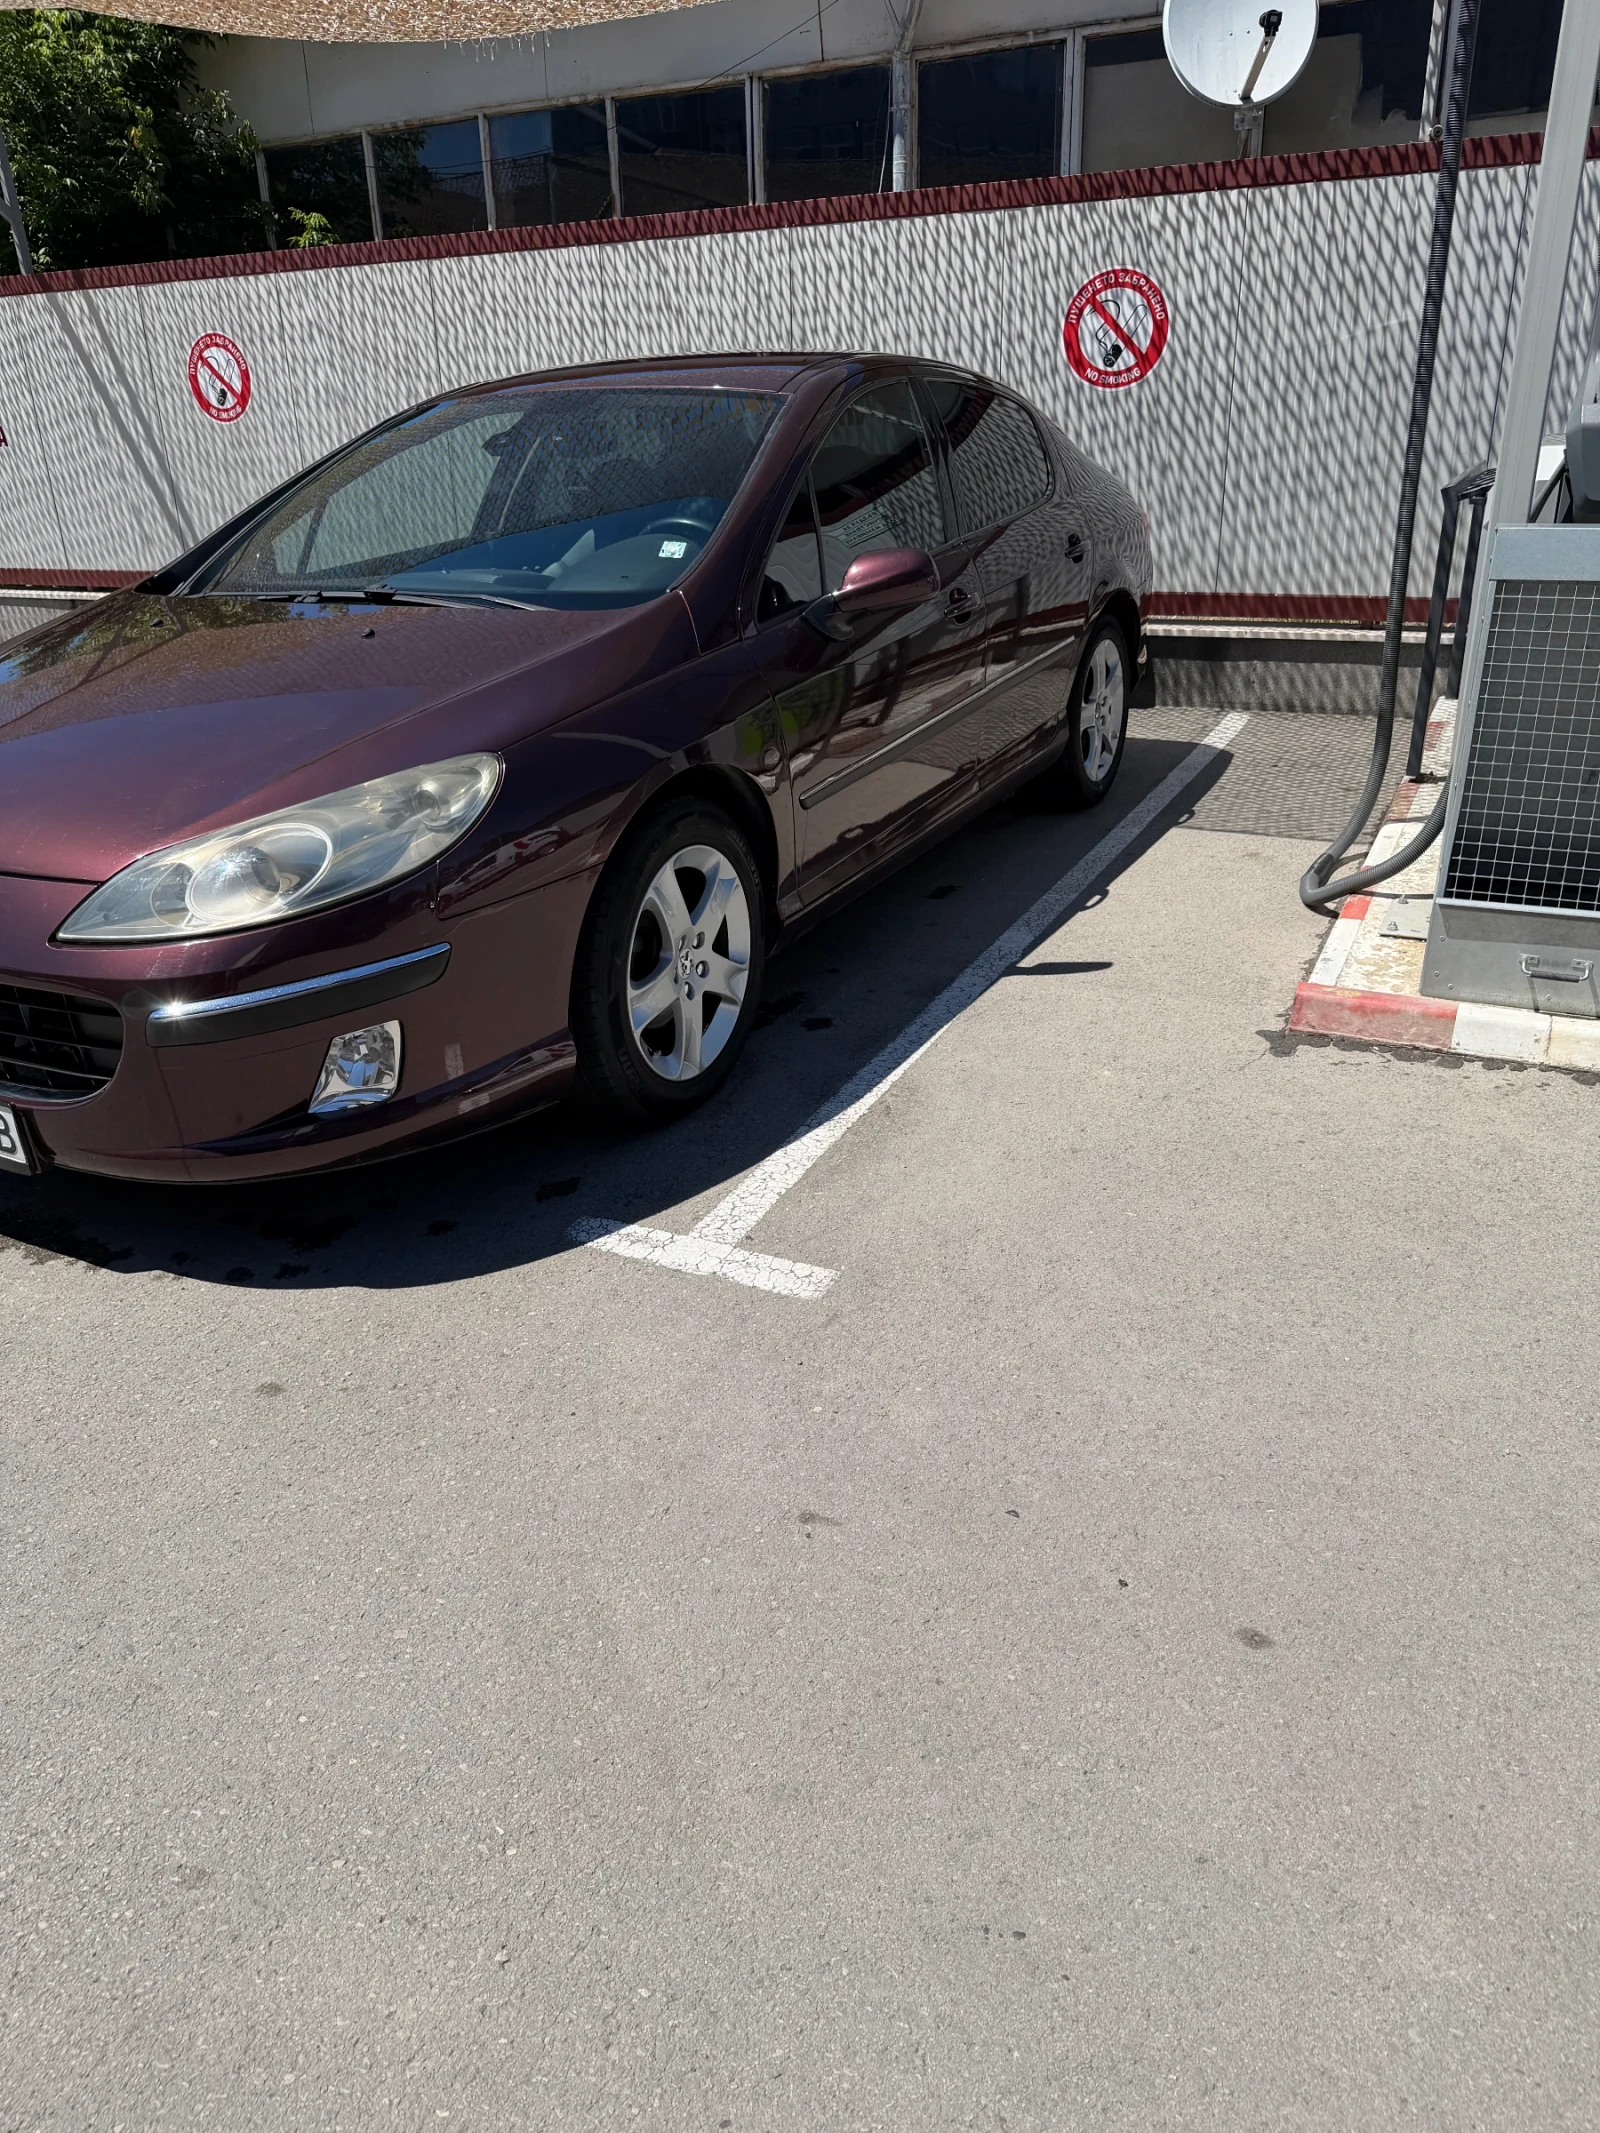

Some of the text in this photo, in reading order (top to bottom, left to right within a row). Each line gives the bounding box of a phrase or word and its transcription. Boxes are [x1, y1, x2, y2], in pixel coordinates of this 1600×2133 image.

[1067, 272, 1165, 324] ПУШЕНЕТО ЗАБРАНЕНО
[189, 335, 246, 375] ПУШЕНЕТО ЗАБРАНЕНО
[1084, 367, 1141, 385] NO SMOKING
[209, 405, 242, 419] NO SMOKING
